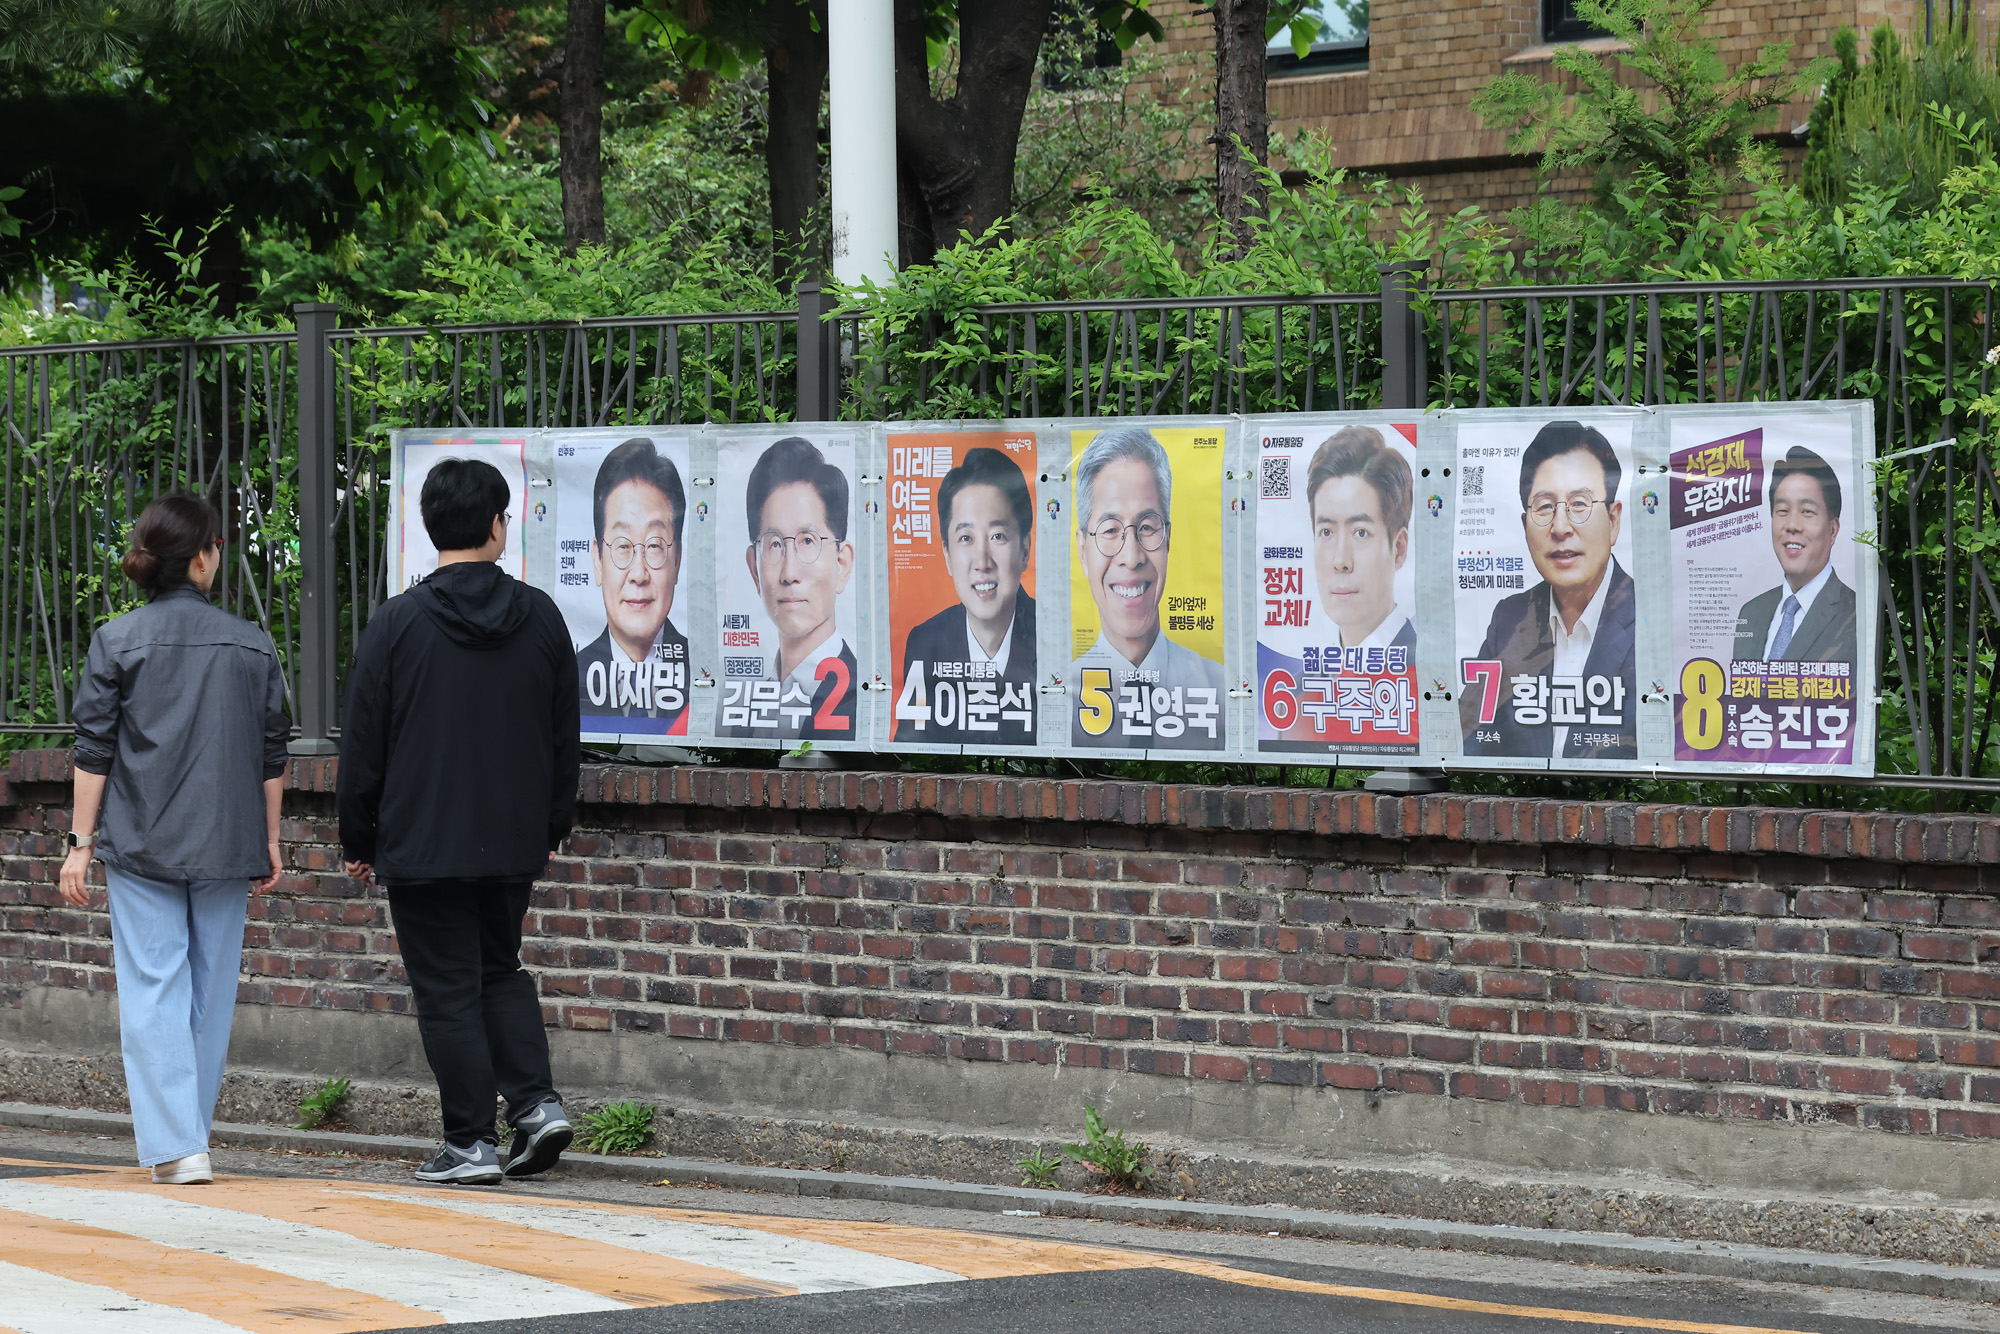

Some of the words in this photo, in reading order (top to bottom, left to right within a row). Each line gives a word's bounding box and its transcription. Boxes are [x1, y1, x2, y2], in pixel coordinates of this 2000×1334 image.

[558, 447, 575, 456] 민주당
[1004, 438, 1032, 454] 개혁신당
[1194, 438, 1218, 446] 민주노동당
[1270, 436, 1304, 448] 자유통일당
[1462, 448, 1481, 458] 출마엔
[1482, 448, 1502, 458] 이유가
[1504, 447, 1520, 458] 있다!
[892, 446, 953, 478] 미래를
[1686, 439, 1750, 483] 선경제,
[892, 480, 931, 512] 여는
[1684, 472, 1752, 518] 후정치!
[892, 513, 932, 545] 선택
[560, 540, 590, 552] 이제부터
[1264, 546, 1303, 559] 광화문정신
[560, 556, 576, 569] 진짜
[1458, 557, 1494, 572] 부정선거
[1496, 557, 1524, 572] 척결로
[560, 573, 590, 586] 대한민국
[1264, 567, 1303, 596] 정치
[1458, 574, 1495, 590] 청년에게
[1496, 574, 1524, 590] 미래를
[1168, 596, 1206, 612] 갈아엎자!
[1264, 599, 1312, 627] 교체!
[722, 614, 750, 630] 새롭게
[1168, 616, 1195, 631] 불평등
[1196, 616, 1215, 631] 세상
[653, 643, 684, 659] 지금은
[723, 632, 760, 646] 대한민국
[726, 660, 762, 674] 정정당당
[932, 661, 963, 678] 새로운
[964, 661, 997, 679] 대통령
[1731, 660, 1768, 675] 실천하는
[1769, 661, 1798, 676] 준비된
[1800, 662, 1850, 676] 경제대통령
[586, 660, 685, 710] 이재명
[814, 656, 850, 730] 2
[895, 660, 932, 730] 4
[1460, 658, 1502, 724] 7
[1731, 676, 1799, 700] 경제·금융
[1801, 677, 1851, 700] 해결사
[722, 680, 812, 729] 김문수
[934, 681, 1032, 732] 이준석
[1078, 668, 1115, 736] 5
[1118, 685, 1220, 739] 권영국
[1263, 668, 1299, 732] 6
[1302, 678, 1416, 735] 구주와
[1510, 674, 1626, 726] 황교안
[1680, 656, 1726, 750] 8
[1476, 730, 1501, 744] 무소속
[1727, 704, 1738, 748] 무소속
[1739, 704, 1850, 750] 송진호
[1572, 733, 1582, 746] 전
[1583, 734, 1620, 748] 국무총리
